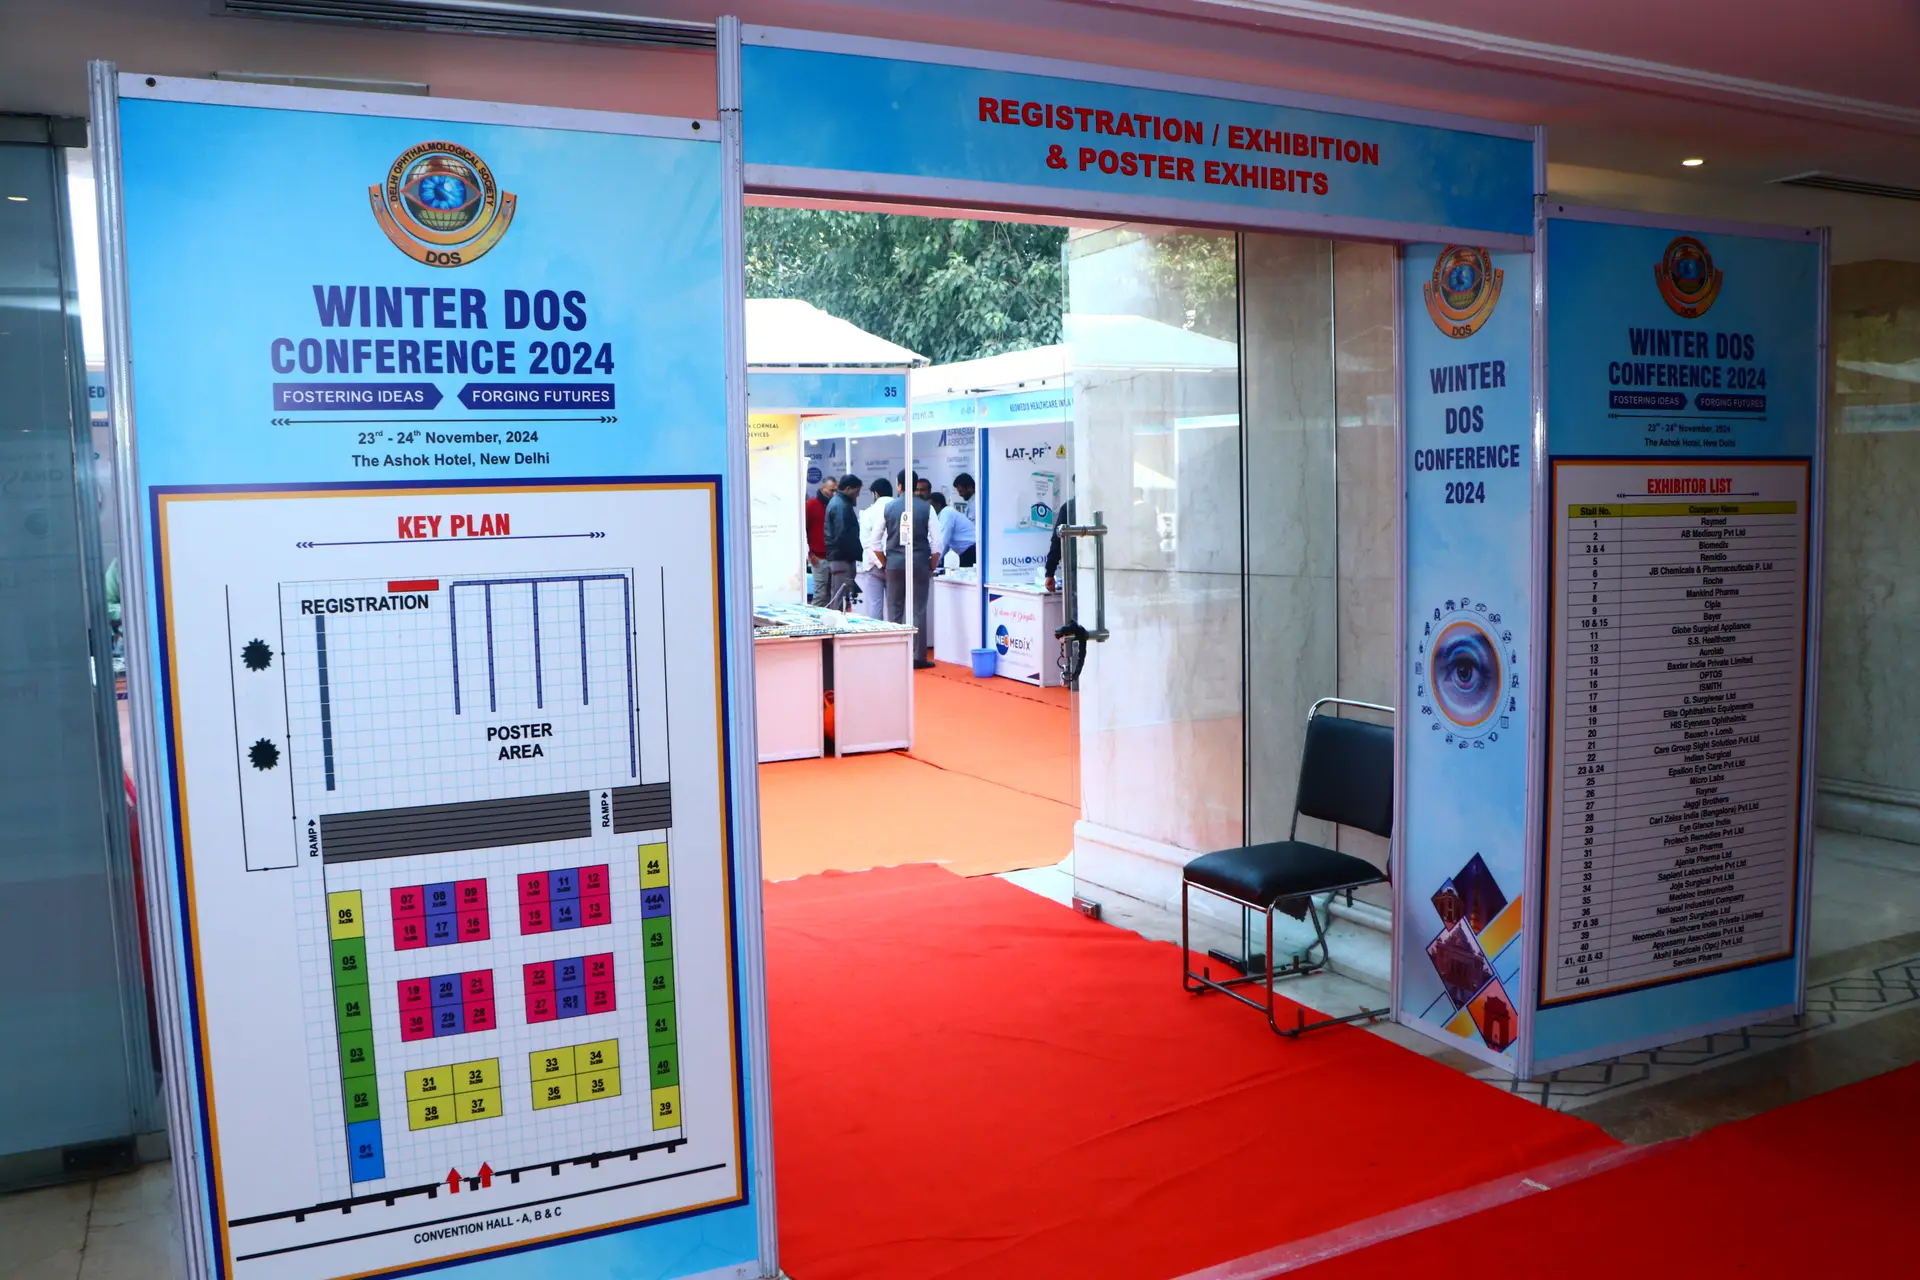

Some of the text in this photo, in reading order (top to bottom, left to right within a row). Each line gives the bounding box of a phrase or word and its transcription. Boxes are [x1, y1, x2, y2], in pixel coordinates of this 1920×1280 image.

[978, 97, 1379, 166] REGISTRATION / EXHIBITION
[390, 142, 495, 206] DELHI OPHTHALMOLOGICAL SOCIETY
[1046, 143, 1329, 196] & POSTER EXHIBITS
[425, 251, 462, 265] DOS
[312, 285, 586, 331] WINTER DOS
[1452, 325, 1472, 337] DOS
[1629, 327, 1755, 361] WINTER DOS
[270, 338, 614, 375] CONFERENCE 2024
[1430, 360, 1506, 394] WINTER
[1608, 361, 1766, 389] CONFERENCE 2024
[283, 389, 424, 403] FOSTERING IDEAS
[472, 390, 610, 403] FORGING FUTURES
[884, 387, 897, 397] 35
[1030, 400, 1058, 410] HEALTHCARE
[1613, 395, 1680, 405] FOSTERING IDEAS
[1700, 397, 1764, 408] FORGING FUTURES
[1446, 405, 1484, 434] DOS
[1715, 424, 1731, 433] 2024
[358, 429, 383, 445] 23rd
[397, 429, 421, 445] 24th
[425, 432, 501, 445] November,
[506, 431, 539, 443] 2024
[1644, 438, 1657, 446] The
[1659, 438, 1681, 447] Ashok
[1703, 439, 1717, 447] New
[1719, 439, 1736, 448] Delhi
[352, 452, 550, 468] The Ashok Hotel, New Delhi
[1414, 444, 1520, 471] CONFERENCE
[1647, 478, 1732, 494] EXHIBITOR LIST
[1445, 482, 1485, 504] 2024
[1580, 507, 1597, 515] Stall
[1688, 506, 1720, 514] Company
[397, 513, 510, 539] KEY PLAN
[1681, 530, 1690, 538] AB
[1592, 582, 1598, 590] 7
[1703, 577, 1723, 585] Roche
[1686, 588, 1739, 597] Mankind Pharma
[301, 594, 429, 615] REGISTRATION
[1704, 612, 1722, 622] Bayer
[1672, 623, 1751, 634] Globe Surgical Appliance
[1700, 670, 1723, 679] OPTOS
[487, 723, 553, 741] POSTER
[498, 743, 544, 760] AREA
[1690, 774, 1725, 784] Micro Labs
[601, 799, 610, 827] RAMP
[310, 827, 319, 857] RAMP
[1684, 842, 1723, 854] Sun Pharma
[647, 860, 659, 869] 44
[558, 877, 569, 886] 11
[588, 873, 599, 883] 12
[528, 880, 540, 890] 10
[433, 891, 446, 901] 08
[464, 887, 477, 897] 09
[401, 894, 414, 904] 07
[645, 895, 665, 904] 44A
[559, 907, 571, 916] 14
[589, 903, 600, 913] 13
[338, 909, 352, 919] 06
[529, 910, 541, 920] 15
[436, 921, 448, 931] 17
[467, 918, 479, 927] 16
[650, 933, 662, 942] 43
[342, 956, 356, 966] 05
[563, 966, 575, 976] 23
[592, 962, 604, 971] 24
[533, 970, 545, 980] 22
[471, 978, 483, 988] 21
[653, 976, 665, 985] 42
[408, 986, 420, 995] 19
[440, 982, 453, 992] 20
[594, 990, 606, 1000] 25
[346, 1002, 360, 1012] 04
[535, 999, 547, 1009] 27
[473, 1008, 485, 1018] 28
[410, 1016, 423, 1026] 30
[655, 1019, 667, 1028] 41
[350, 1048, 363, 1058] 03
[590, 1051, 602, 1061] 34
[545, 1058, 558, 1068] 33
[657, 1060, 669, 1070] 40
[469, 1070, 482, 1080] 32
[422, 1077, 435, 1087] 31
[592, 1079, 604, 1089] 35
[548, 1086, 560, 1096] 36
[354, 1093, 367, 1103] 02
[471, 1099, 484, 1109] 37
[660, 1102, 671, 1111] 39
[424, 1106, 438, 1117] 38
[359, 1144, 372, 1154] 01
[414, 1221, 484, 1245] CONVENTION
[486, 1215, 514, 1231] HALL
[522, 1213, 533, 1225] A,
[534, 1210, 542, 1221] B
[544, 1208, 552, 1219] &
[554, 1206, 562, 1218] C
